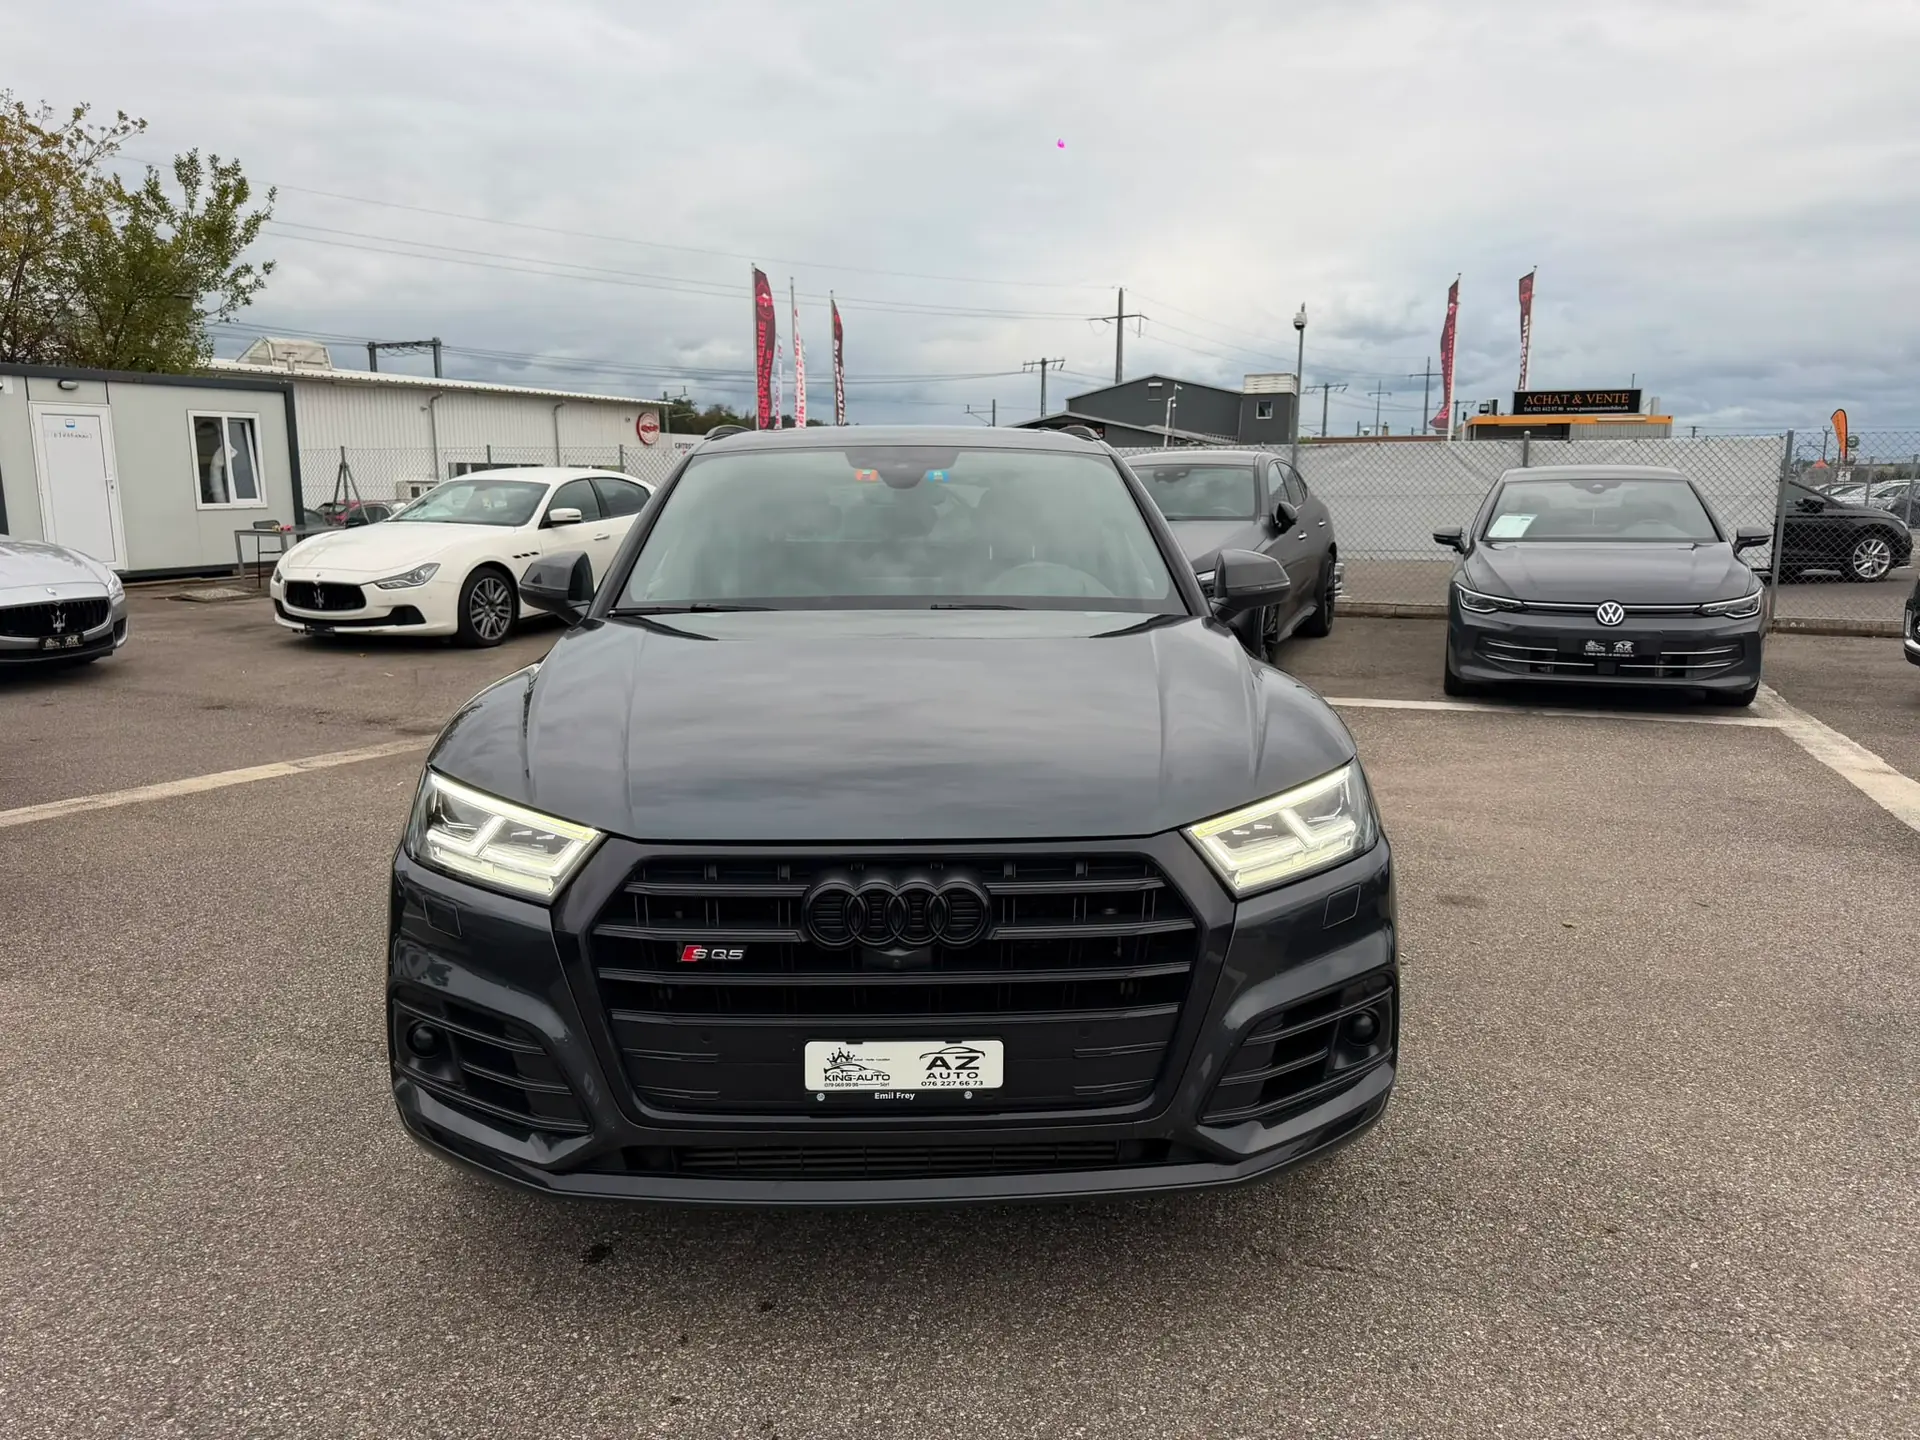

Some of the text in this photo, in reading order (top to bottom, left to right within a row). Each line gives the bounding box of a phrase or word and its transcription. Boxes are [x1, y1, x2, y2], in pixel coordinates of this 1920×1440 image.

[1524, 392, 1630, 405] ACHAT & VENTE
[925, 1056, 980, 1071] AZ
[824, 1074, 891, 1082] KING-AUTO
[925, 1071, 979, 1080] AUTO
[874, 1091, 916, 1101] Emil Frey
